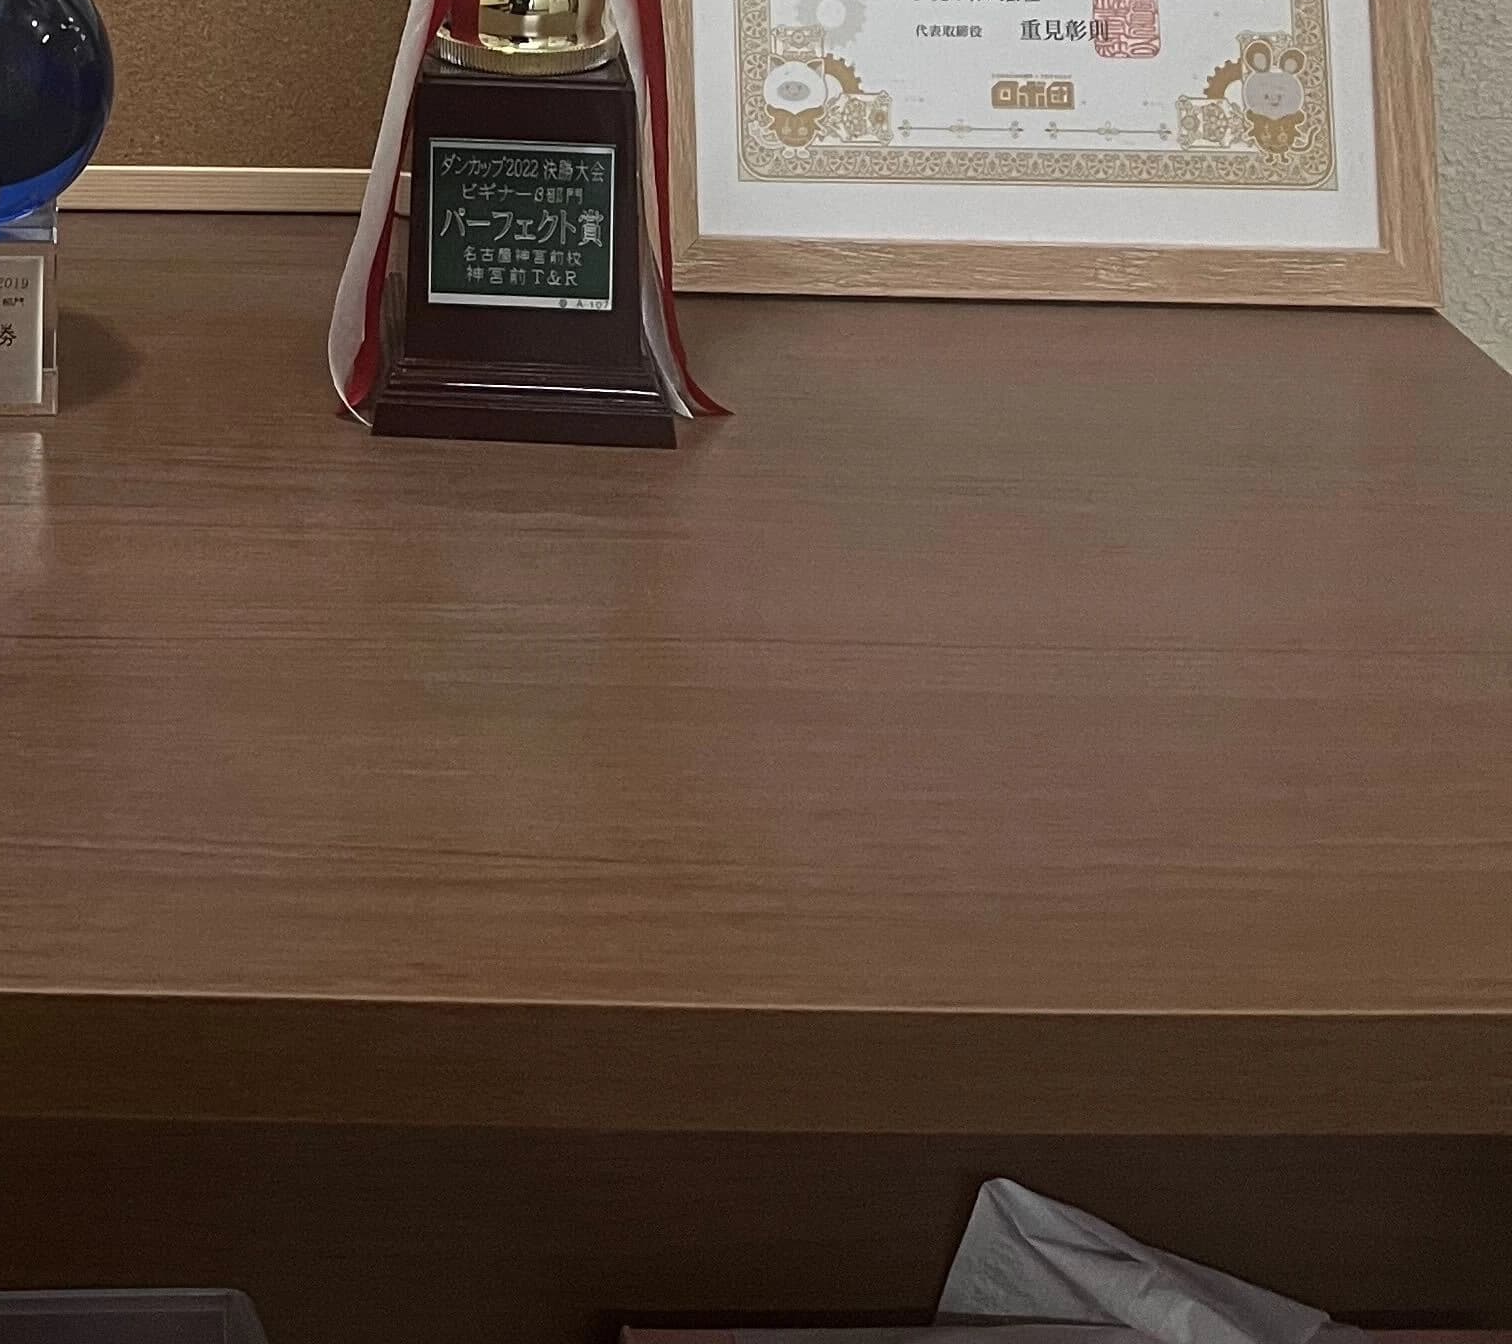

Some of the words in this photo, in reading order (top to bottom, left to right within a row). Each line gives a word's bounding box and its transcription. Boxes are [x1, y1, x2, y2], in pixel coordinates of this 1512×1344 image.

[915, 23, 984, 39] 代表取締役
[439, 207, 605, 248] パーフェクト賞
